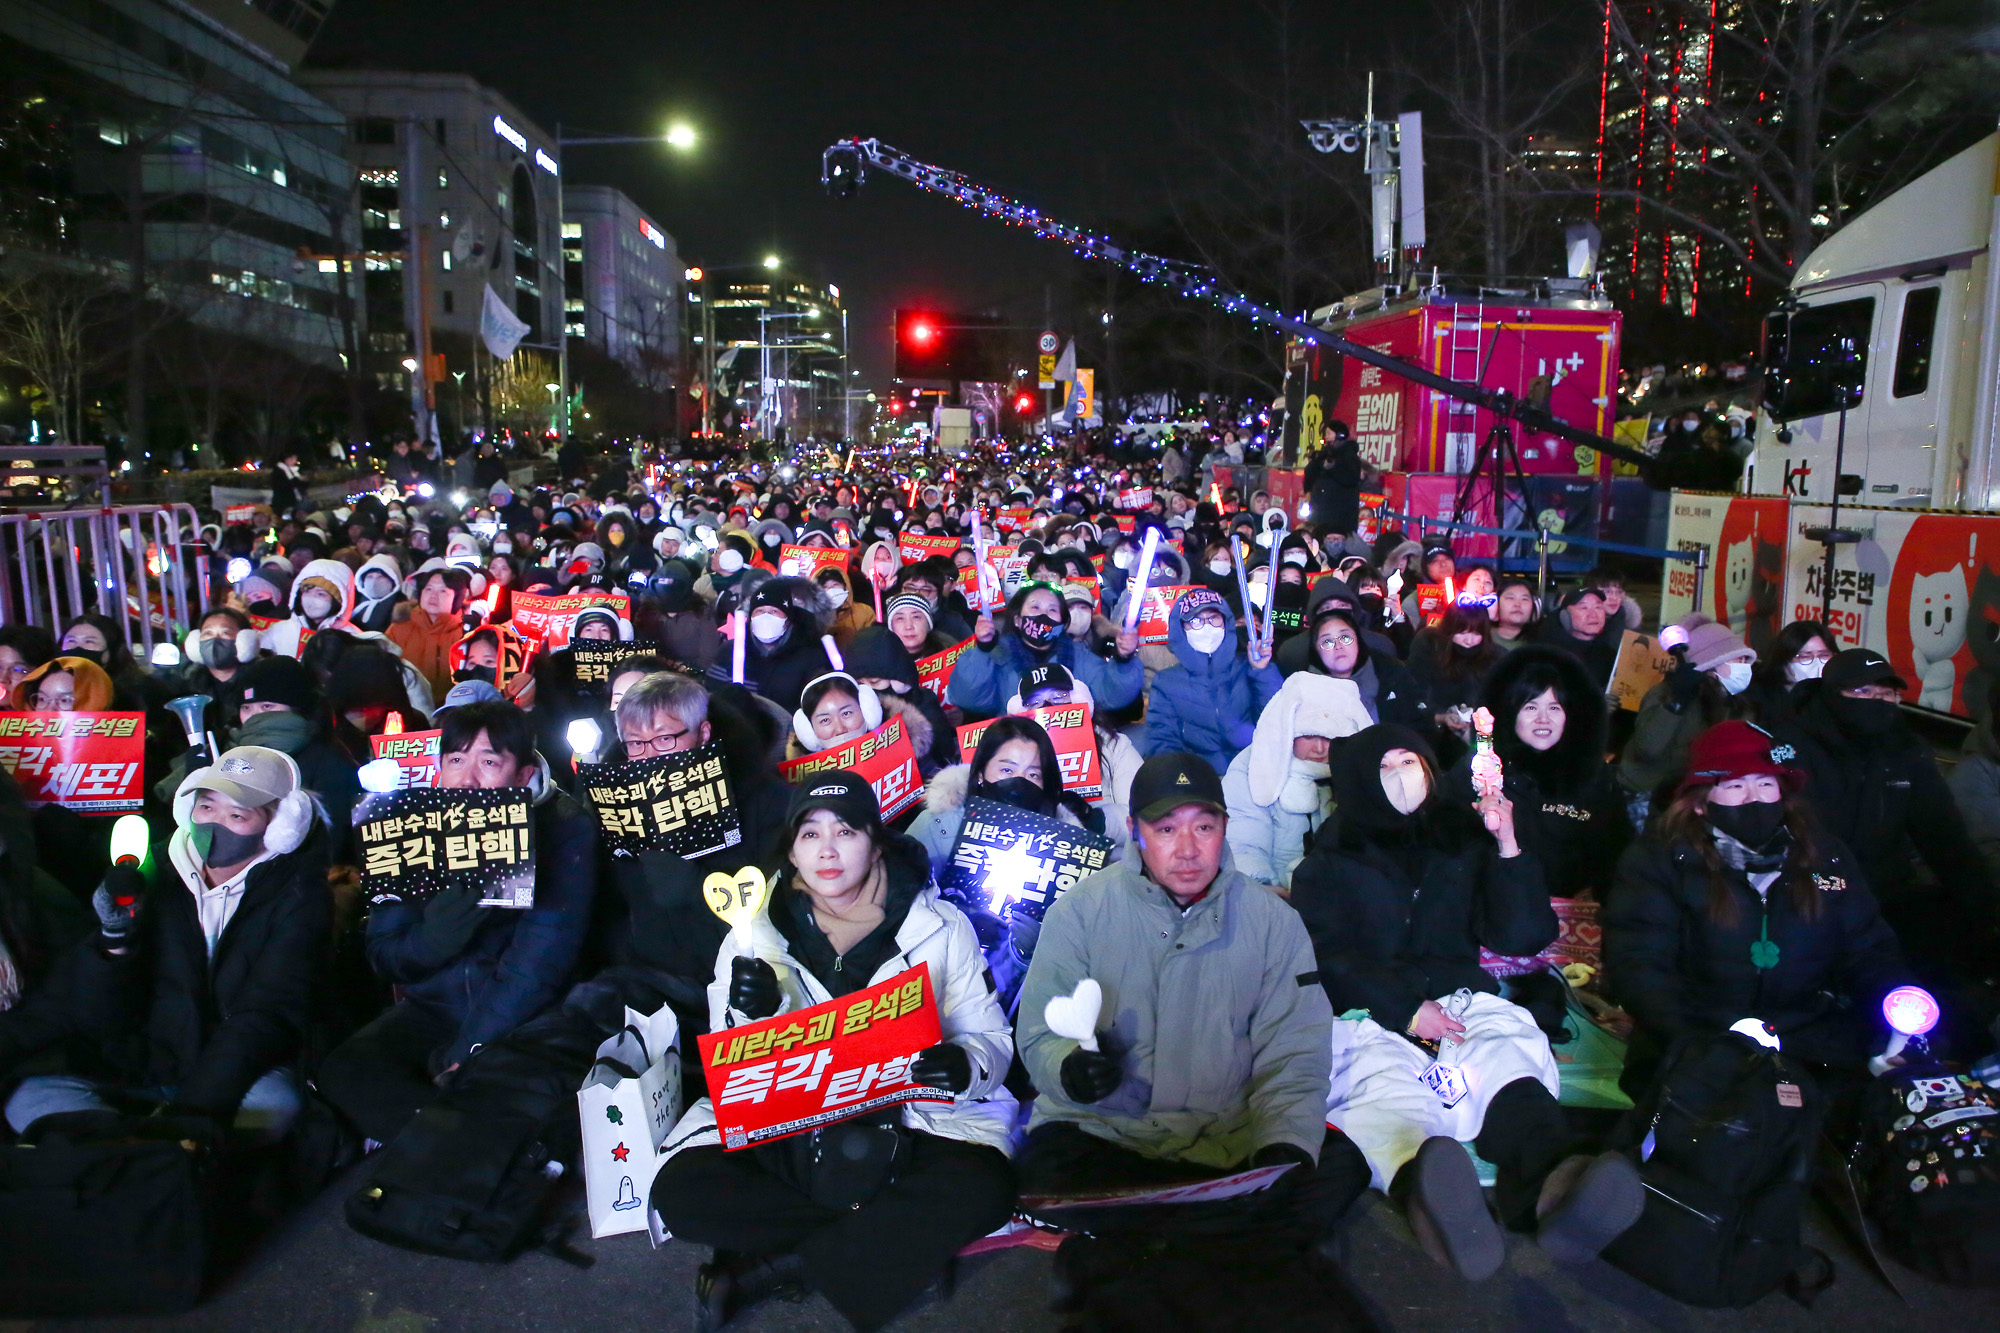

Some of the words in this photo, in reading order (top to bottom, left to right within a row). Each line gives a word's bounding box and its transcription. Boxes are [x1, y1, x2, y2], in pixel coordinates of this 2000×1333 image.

[1043, 338, 1055, 348] 30
[1356, 392, 1399, 432] 끝없이
[1782, 459, 1811, 496] kt
[820, 550, 847, 562] 윤석열
[901, 546, 926, 562] 즉각
[989, 548, 1012, 557] 내란수
[1669, 570, 1695, 598] 안전주
[515, 609, 549, 627] 즉각
[551, 597, 592, 611] 내란수괴
[574, 651, 613, 662] 내란수괴
[575, 664, 610, 682] 즉각
[70, 718, 138, 737] 윤석열
[378, 735, 442, 759] 내란수괴
[788, 746, 855, 784] 내란수괴
[860, 720, 900, 762] 윤석열
[40, 762, 139, 796] 체포!
[589, 781, 648, 805] 내란수괴
[668, 756, 723, 792] 윤석열
[1056, 750, 1093, 784] 포!
[361, 811, 442, 842] 내란수괴
[467, 802, 528, 829] 윤석열
[598, 806, 646, 838] 즉각
[652, 779, 730, 834] 탄핵!
[365, 835, 436, 877] 즉각
[445, 828, 529, 870] 탄핵!
[1053, 840, 1106, 868] 윤석열
[711, 1010, 837, 1067] 내란수괴
[842, 975, 924, 1036] 윤석열
[720, 1047, 835, 1106] 즉각
[821, 1050, 923, 1108] 탄핵
